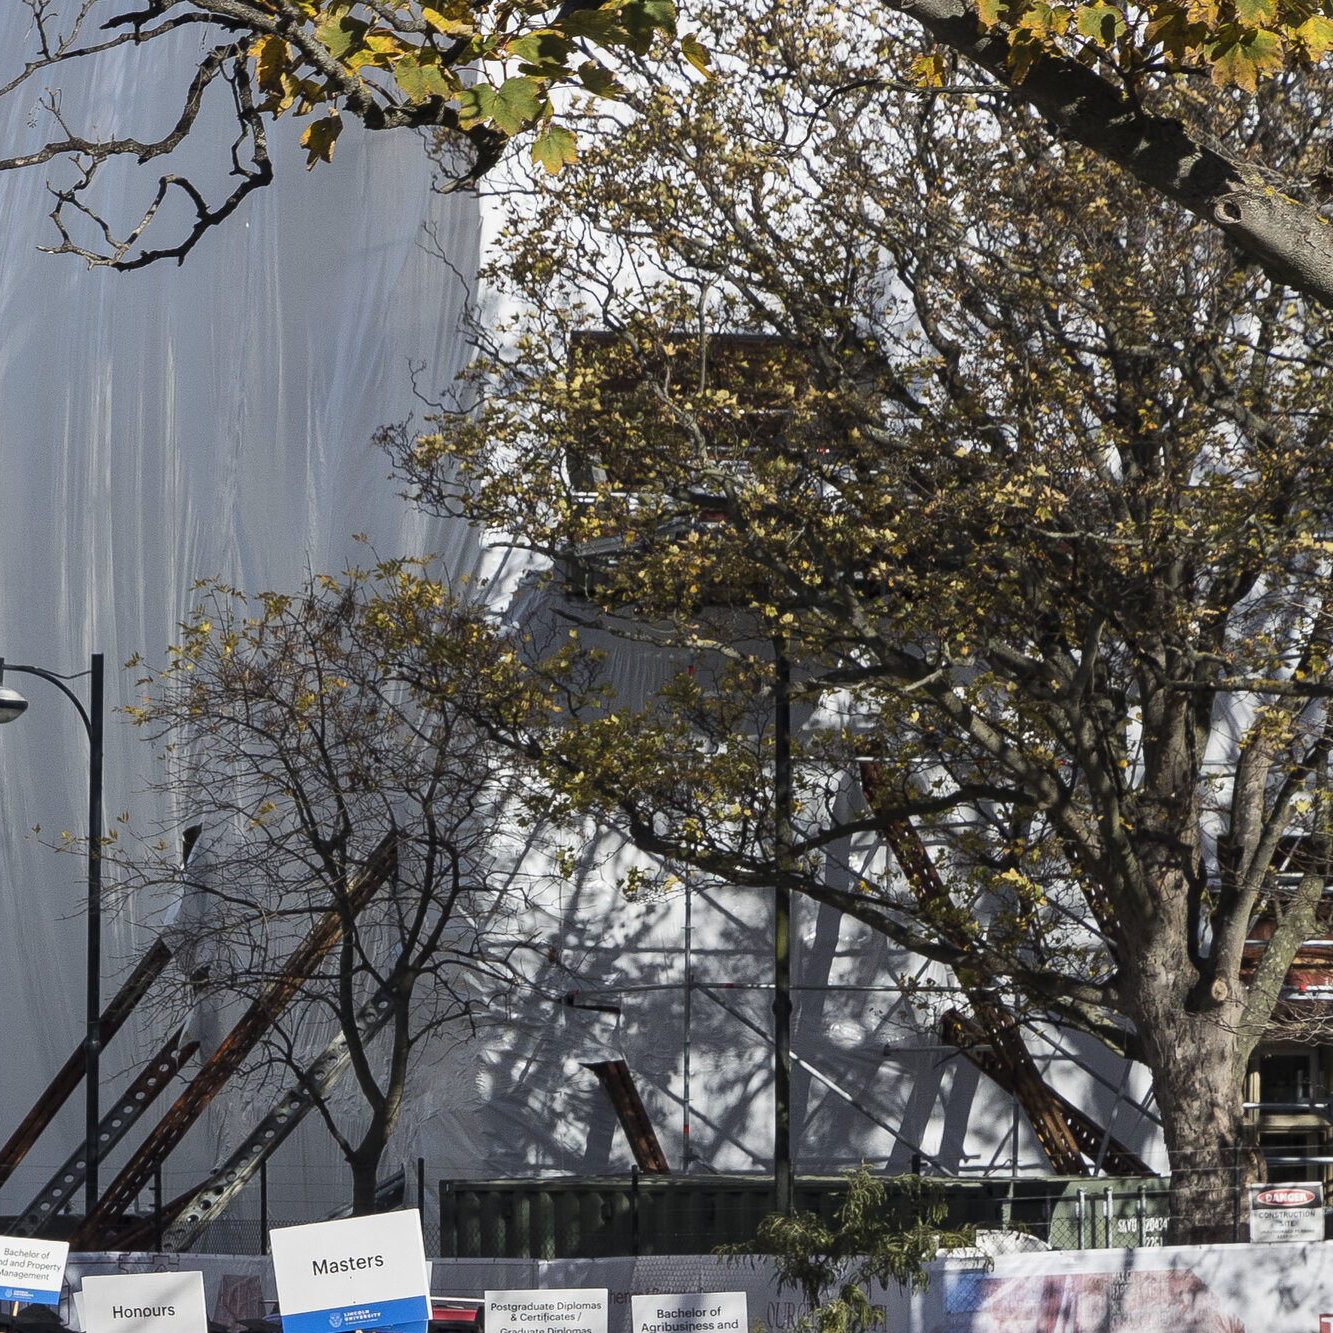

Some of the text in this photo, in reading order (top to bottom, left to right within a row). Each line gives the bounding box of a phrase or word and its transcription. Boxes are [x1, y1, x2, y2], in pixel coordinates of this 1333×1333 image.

[1265, 1192, 1307, 1202] DANGER
[4, 1248, 50, 1260] Bachelor of
[10, 1260, 25, 1268] and
[26, 1261, 61, 1272] Property
[312, 1254, 384, 1276] Masters
[113, 1305, 175, 1319] Honours
[490, 1302, 602, 1312] Postgraduate Diplomas
[657, 1306, 722, 1318] Bachelor of
[344, 1309, 370, 1317] LINCOLN
[344, 1312, 381, 1322] UNIVERSITY
[520, 1312, 575, 1322] Certificates
[577, 1312, 582, 1321] /
[717, 1319, 739, 1330] and
